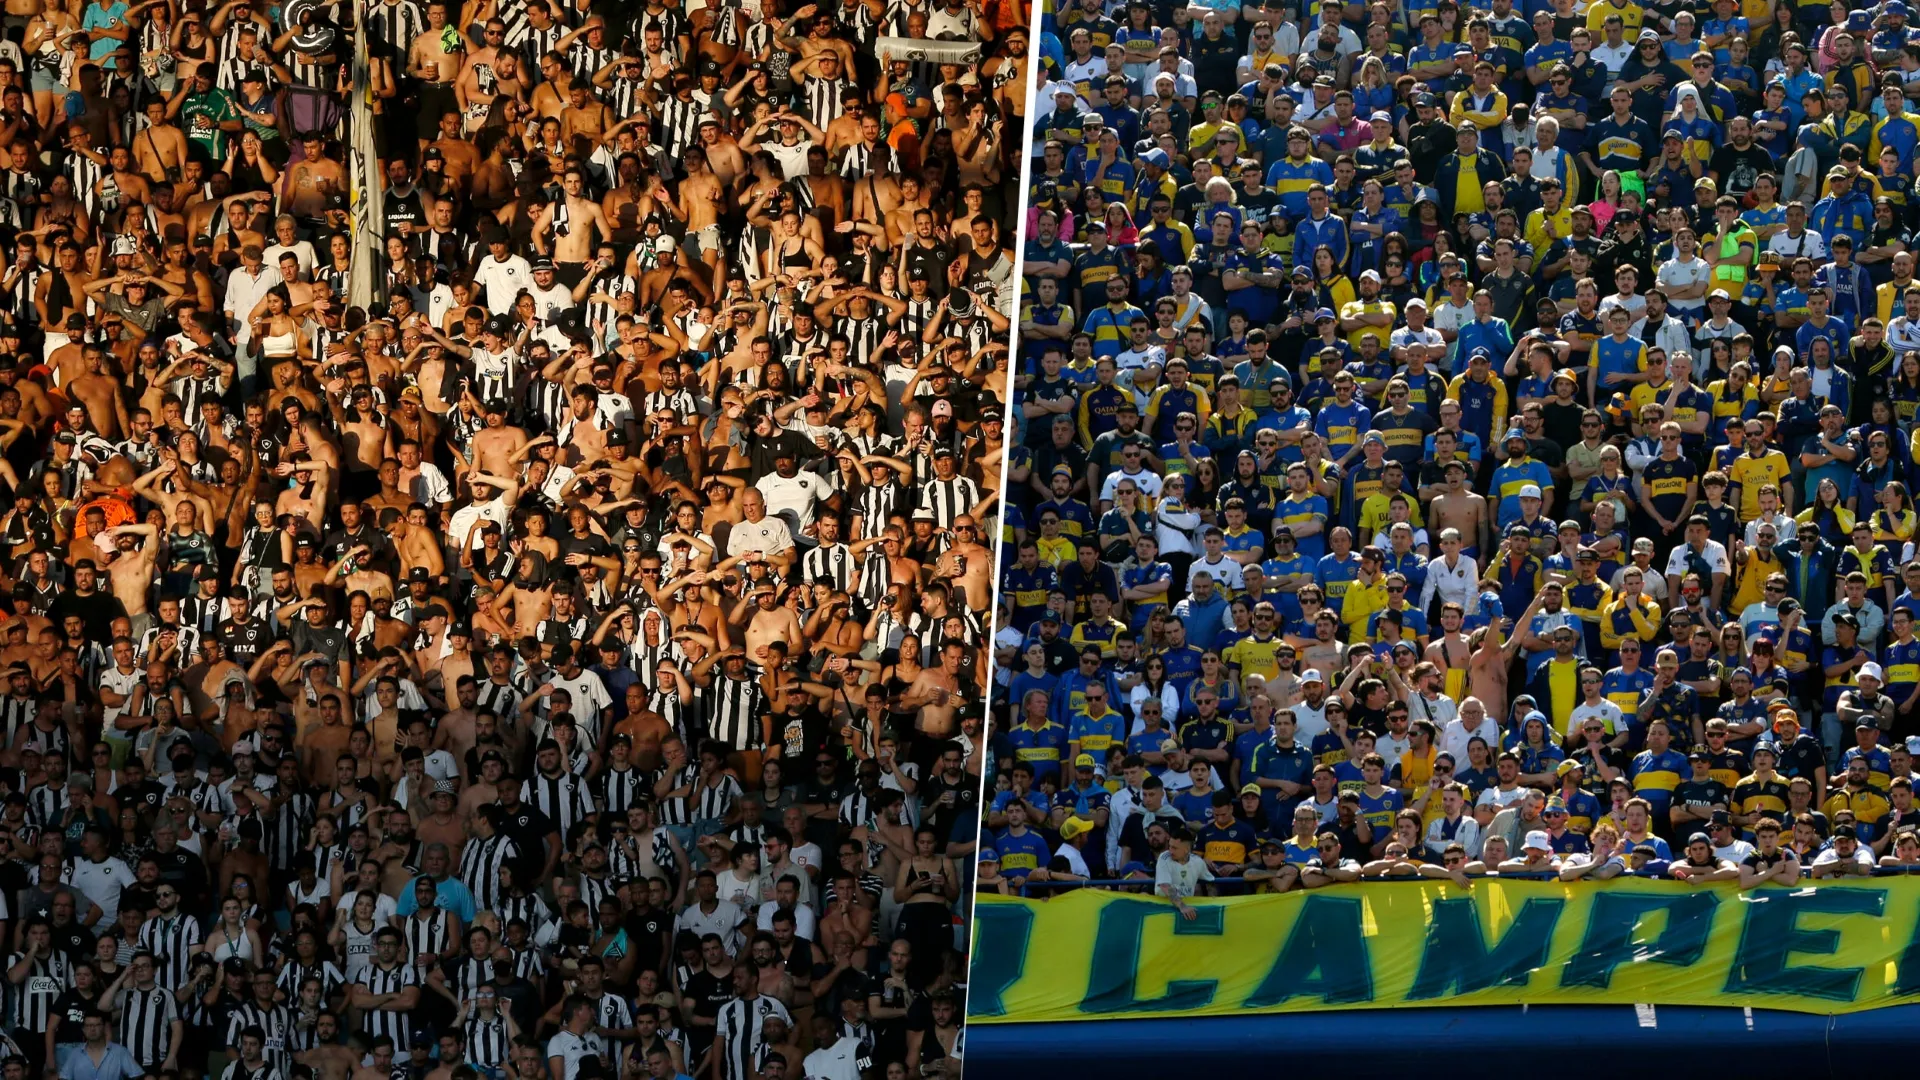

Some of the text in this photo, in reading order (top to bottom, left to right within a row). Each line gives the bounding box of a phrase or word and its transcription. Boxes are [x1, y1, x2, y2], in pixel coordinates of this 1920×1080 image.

[1748, 475, 1769, 483] QATAR
[1656, 482, 1681, 490] MEGATONE
[1079, 887, 1920, 1014] CAMPE
